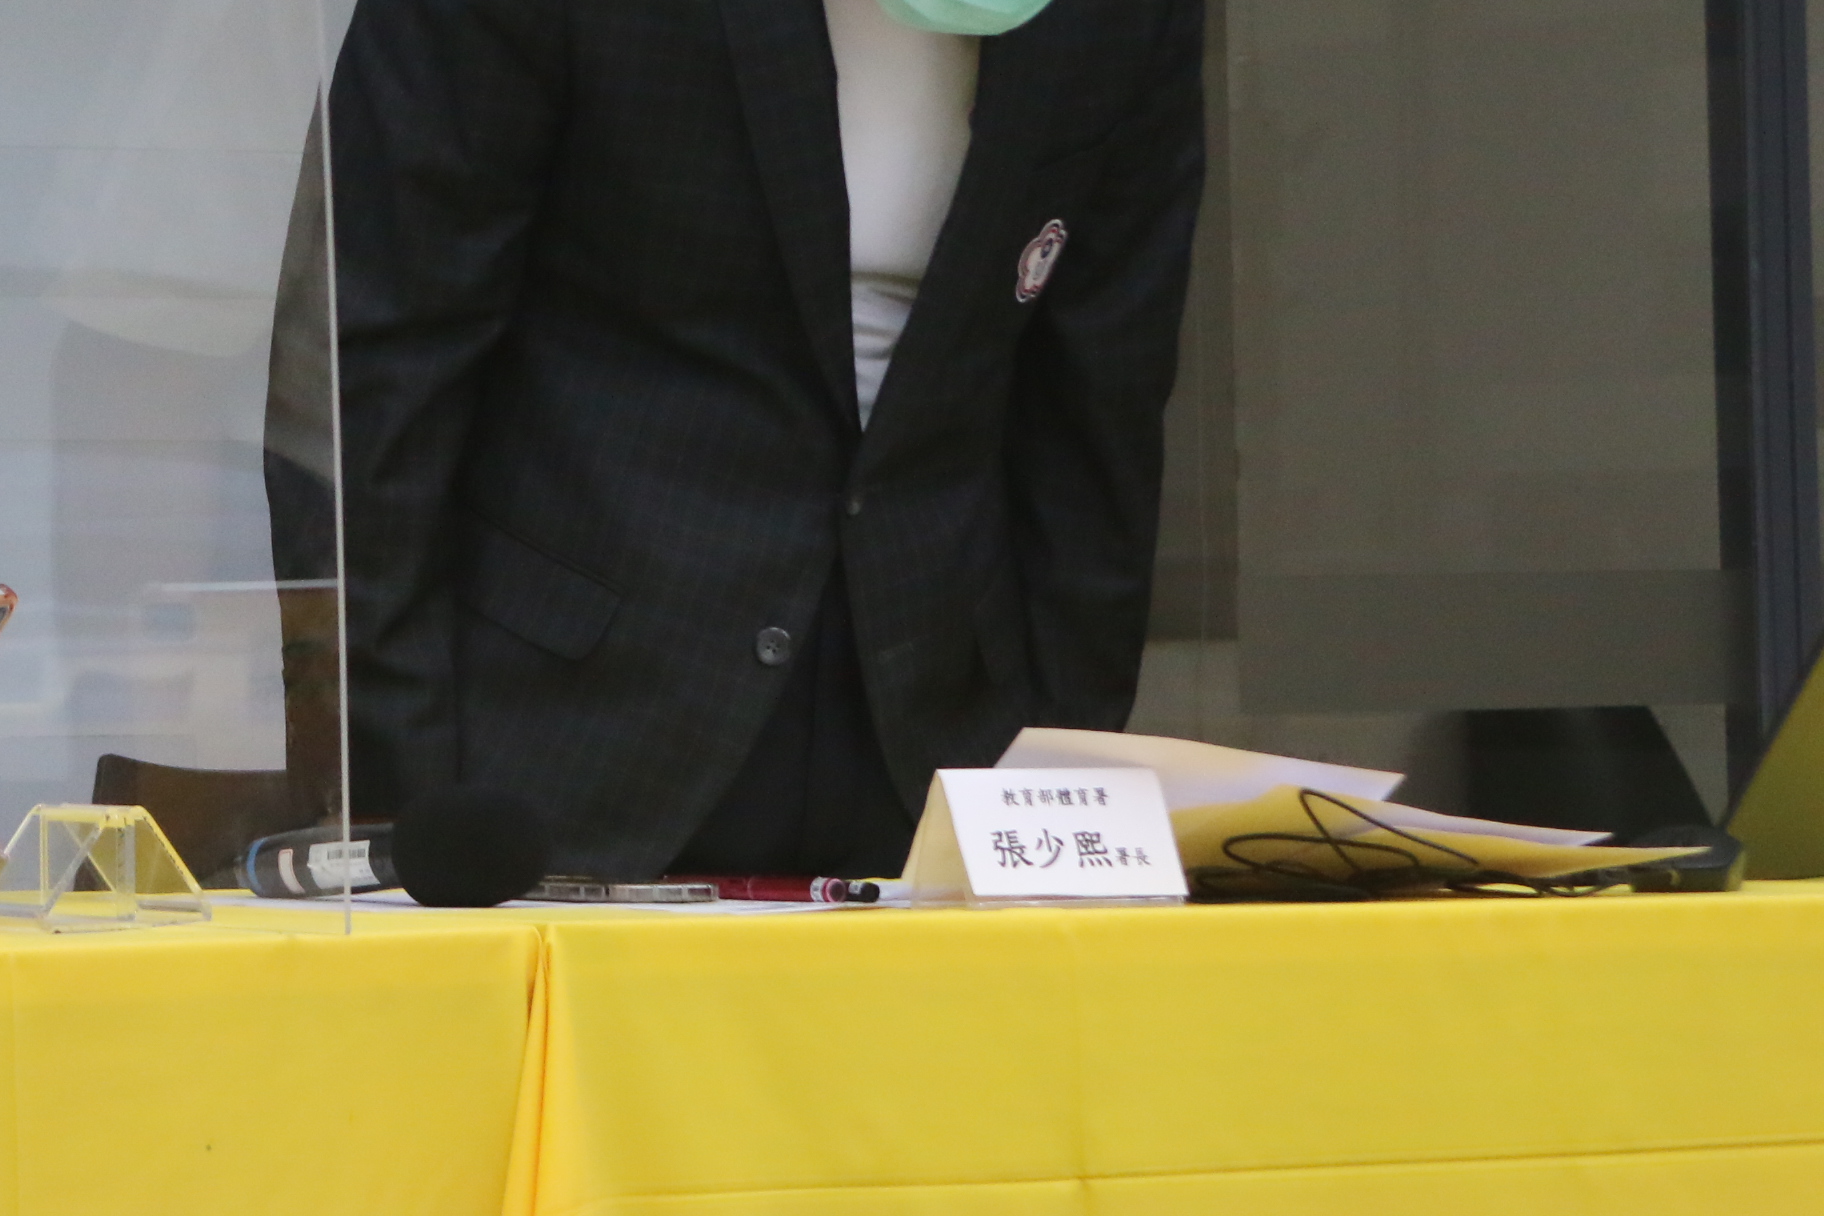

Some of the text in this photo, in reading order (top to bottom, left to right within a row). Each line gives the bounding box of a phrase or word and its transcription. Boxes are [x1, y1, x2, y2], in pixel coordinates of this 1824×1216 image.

[1001, 787, 1109, 806] 教育部體育署
